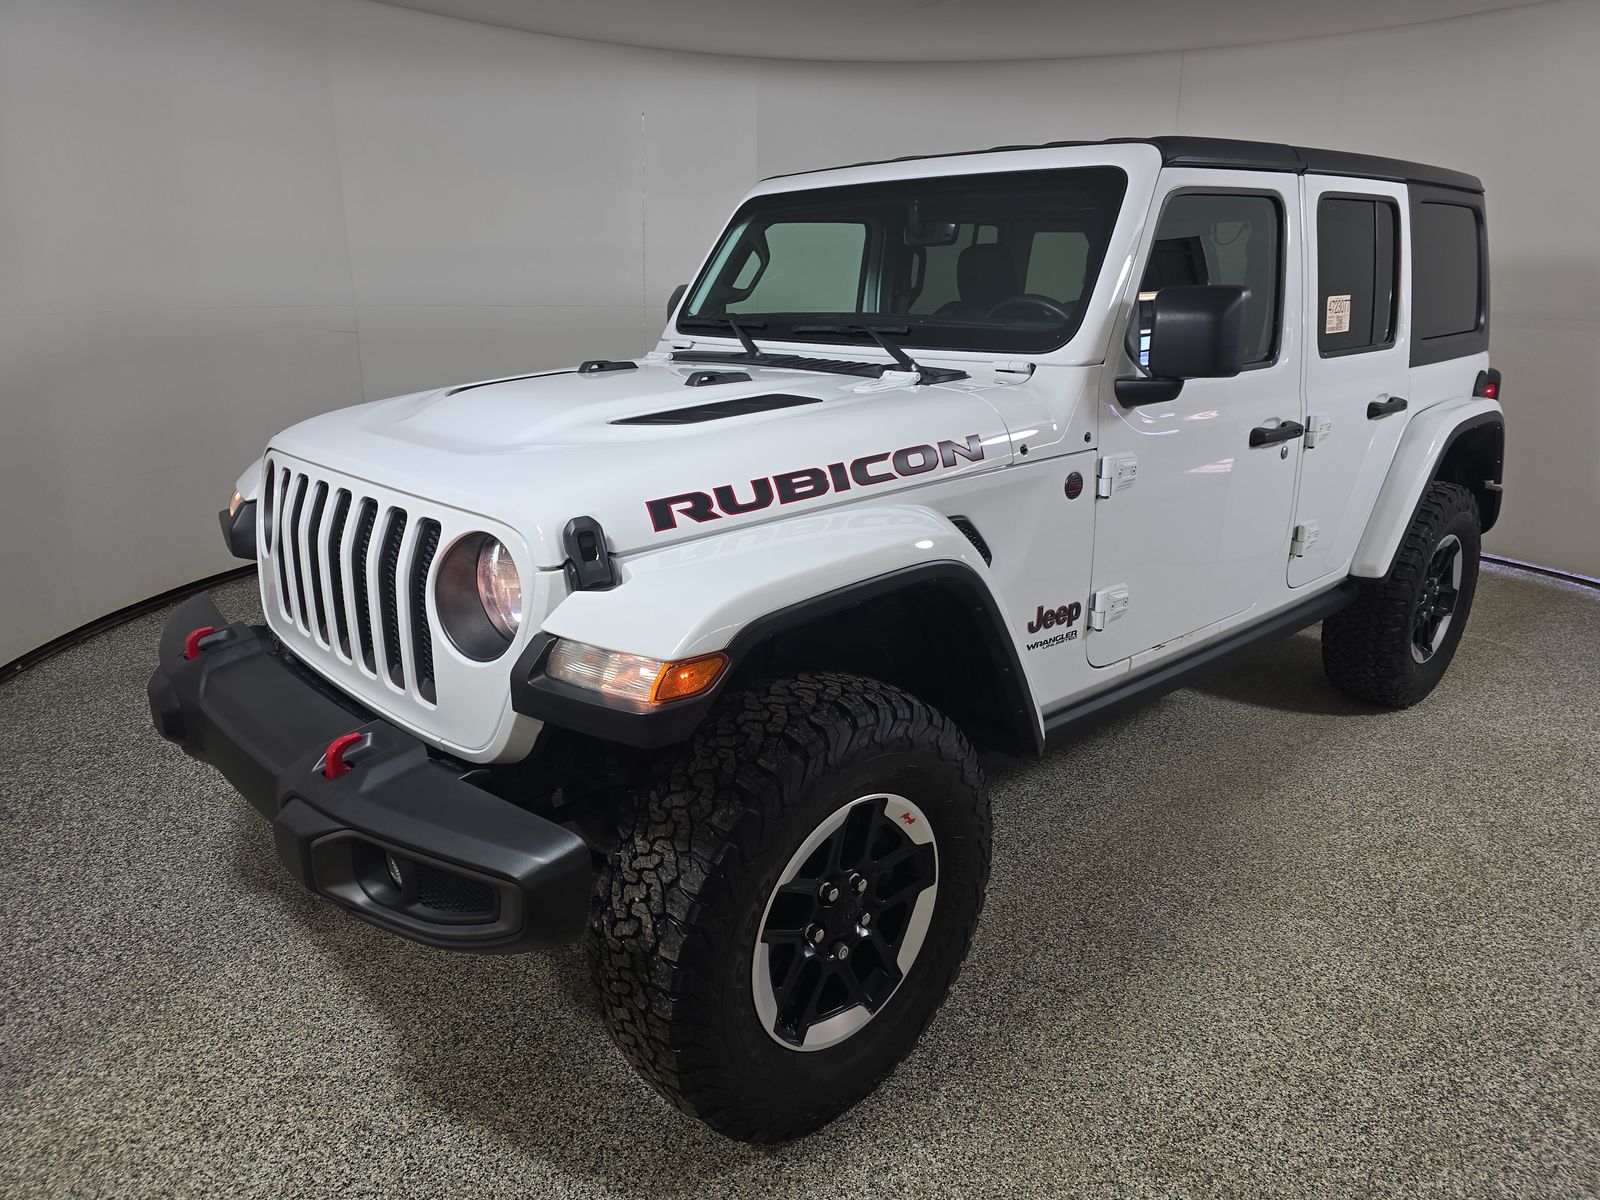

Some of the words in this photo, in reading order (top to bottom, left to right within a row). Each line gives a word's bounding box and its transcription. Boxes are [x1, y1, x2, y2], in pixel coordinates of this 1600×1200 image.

[645, 434, 985, 533] RUBICON
[1027, 601, 1082, 634] Jeep
[1026, 630, 1078, 651] WRANGLER
